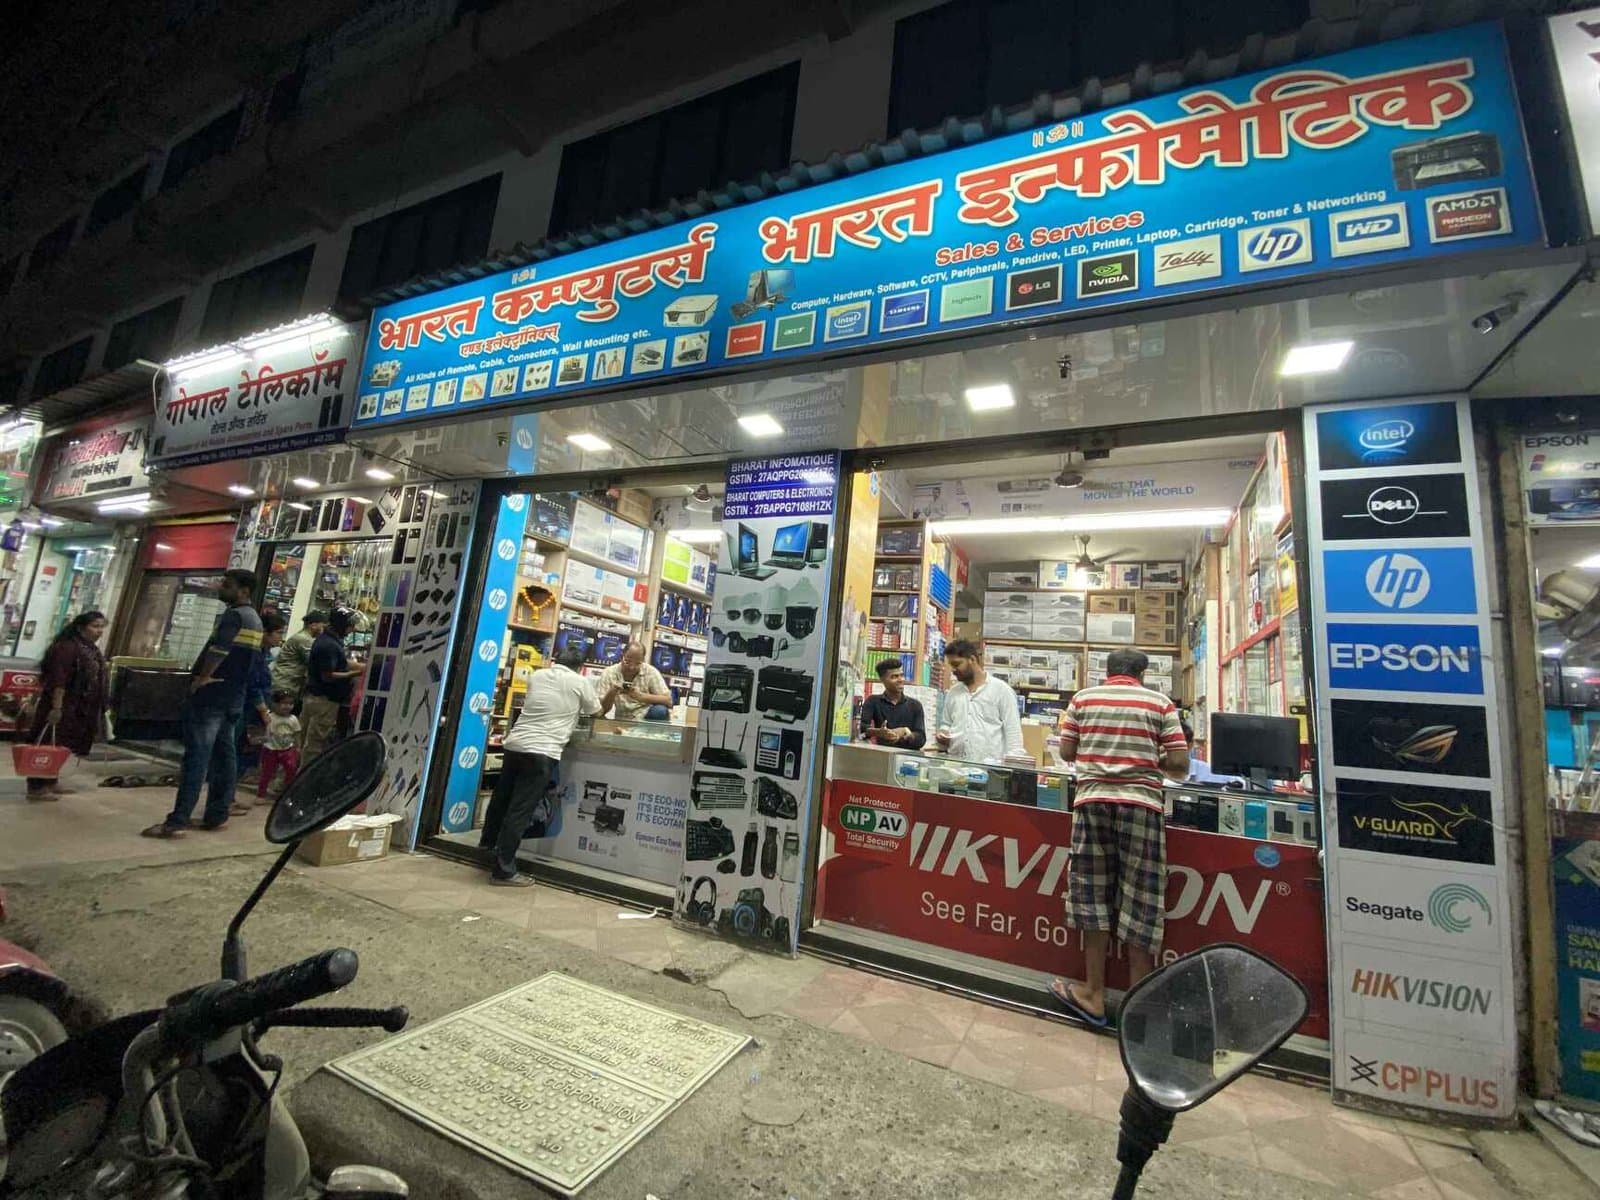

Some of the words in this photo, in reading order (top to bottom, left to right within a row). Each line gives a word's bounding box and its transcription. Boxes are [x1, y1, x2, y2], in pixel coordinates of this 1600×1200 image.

[759, 178, 942, 263] भारत
[956, 57, 1475, 227] इन्फोमेटिक
[833, 288, 875, 303] Hardware,
[877, 279, 919, 293] Software,
[921, 272, 949, 286] CCTV,
[951, 260, 1009, 280] Peripherals,
[1013, 250, 1061, 267] Pendrive,
[1064, 245, 1089, 258] LED,
[1092, 235, 1133, 252] Printer,
[1137, 228, 1181, 244] Laptop,
[1185, 215, 1248, 234] Cartridge,
[1251, 207, 1289, 221] Toner
[1293, 203, 1303, 214] &
[1307, 189, 1386, 212] Networking
[936, 239, 999, 266] Sales
[1005, 232, 1024, 252] &
[1031, 211, 1145, 246] Services
[1252, 227, 1299, 262] hp
[1159, 251, 1215, 272] Tally
[1035, 281, 1051, 290] LG
[377, 296, 486, 351] भारत
[562, 340, 581, 353] Wall
[584, 332, 629, 349] Mounting
[632, 329, 651, 340] etc.
[166, 387, 230, 426] गोपाल
[236, 349, 348, 410] टेलिकॉम
[1367, 426, 1405, 442] intel
[1525, 434, 1589, 448] EPSON
[731, 460, 768, 473] BHARAT
[769, 454, 834, 469] INFOMATIQUE
[729, 474, 753, 485] GSTIN
[1128, 480, 1155, 489] THAT
[726, 491, 749, 502] BHARAT
[749, 489, 785, 501] COMPUTERS
[791, 487, 833, 498] ELECTRONICS
[1126, 488, 1147, 498] THE
[1151, 486, 1194, 497] WORLD
[725, 505, 749, 516] GSTIN
[1371, 499, 1416, 512] DELL
[1373, 553, 1424, 609] hp
[1330, 643, 1470, 673] EPSON
[848, 794, 862, 803] Net
[863, 797, 901, 809] Protector
[846, 832, 865, 842] Total
[866, 835, 900, 849] Security
[921, 891, 966, 924] See
[975, 902, 1023, 940] Far,
[1034, 916, 1068, 946] Go
[1346, 896, 1425, 923] Seagate
[1351, 968, 1492, 1016] HIKVISION
